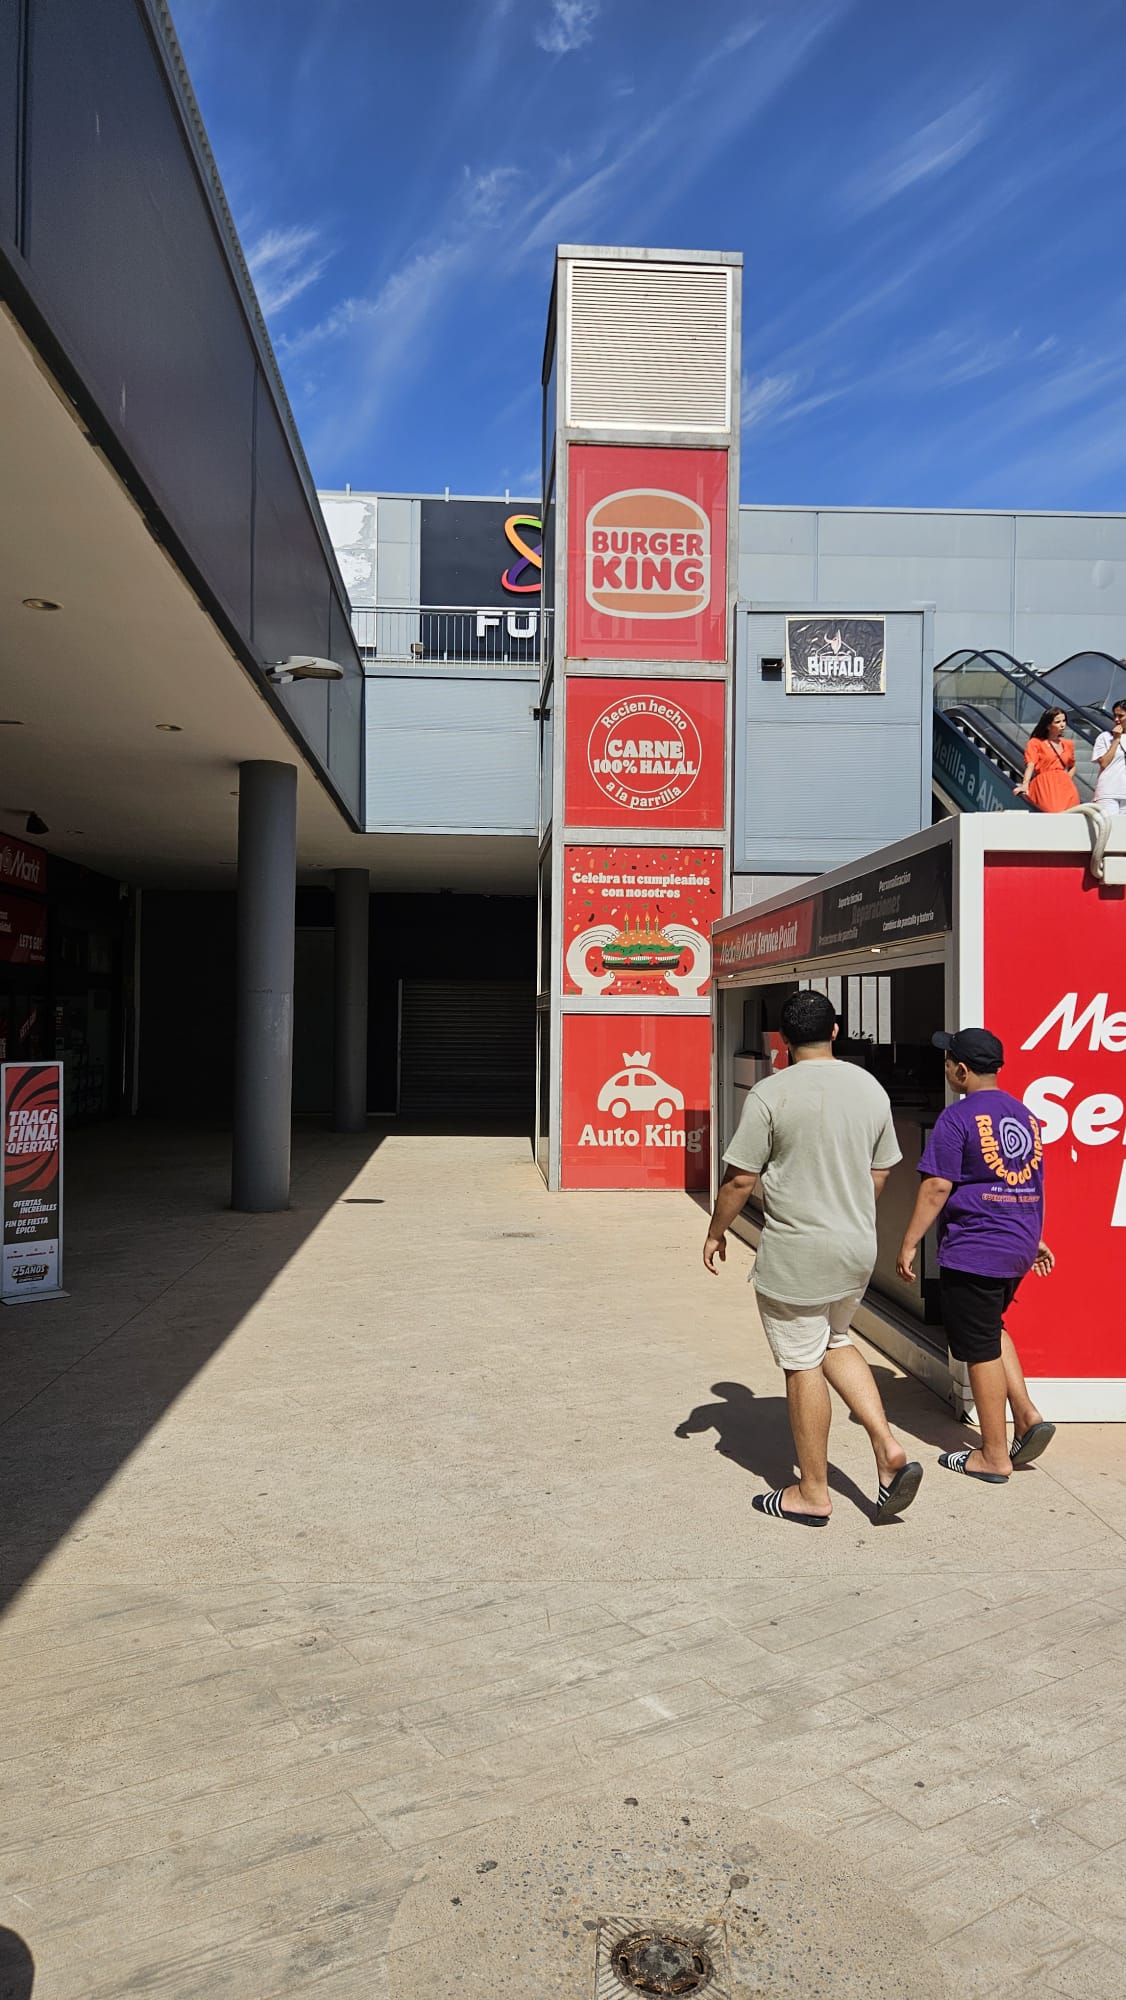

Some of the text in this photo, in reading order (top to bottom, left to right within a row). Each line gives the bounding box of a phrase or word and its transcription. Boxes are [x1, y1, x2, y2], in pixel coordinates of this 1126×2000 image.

[592, 531, 704, 556] BURGER
[592, 556, 704, 591] KING
[476, 611, 547, 639] FU
[807, 655, 865, 678] BUFFALO
[600, 699, 688, 730] Recien hecho
[607, 739, 684, 759] CARNE
[593, 759, 697, 775] 100% HALAL
[605, 781, 682, 809] a la parrilla
[967, 773, 976, 796] a
[572, 872, 711, 888] Celebra tu cumpleaños
[601, 888, 681, 899] con nosotros
[757, 927, 779, 955] Service
[779, 921, 798, 949] Point
[9, 1108, 58, 1126] TRACA
[1022, 1076, 1126, 1146] Se
[8, 1124, 58, 1142] FINAL
[577, 1123, 707, 1153] Auto King
[7, 1140, 58, 1154] OFERTAS
[13, 1198, 42, 1208] OFERTAS
[5, 1217, 48, 1228] FIN DE FIESTA
